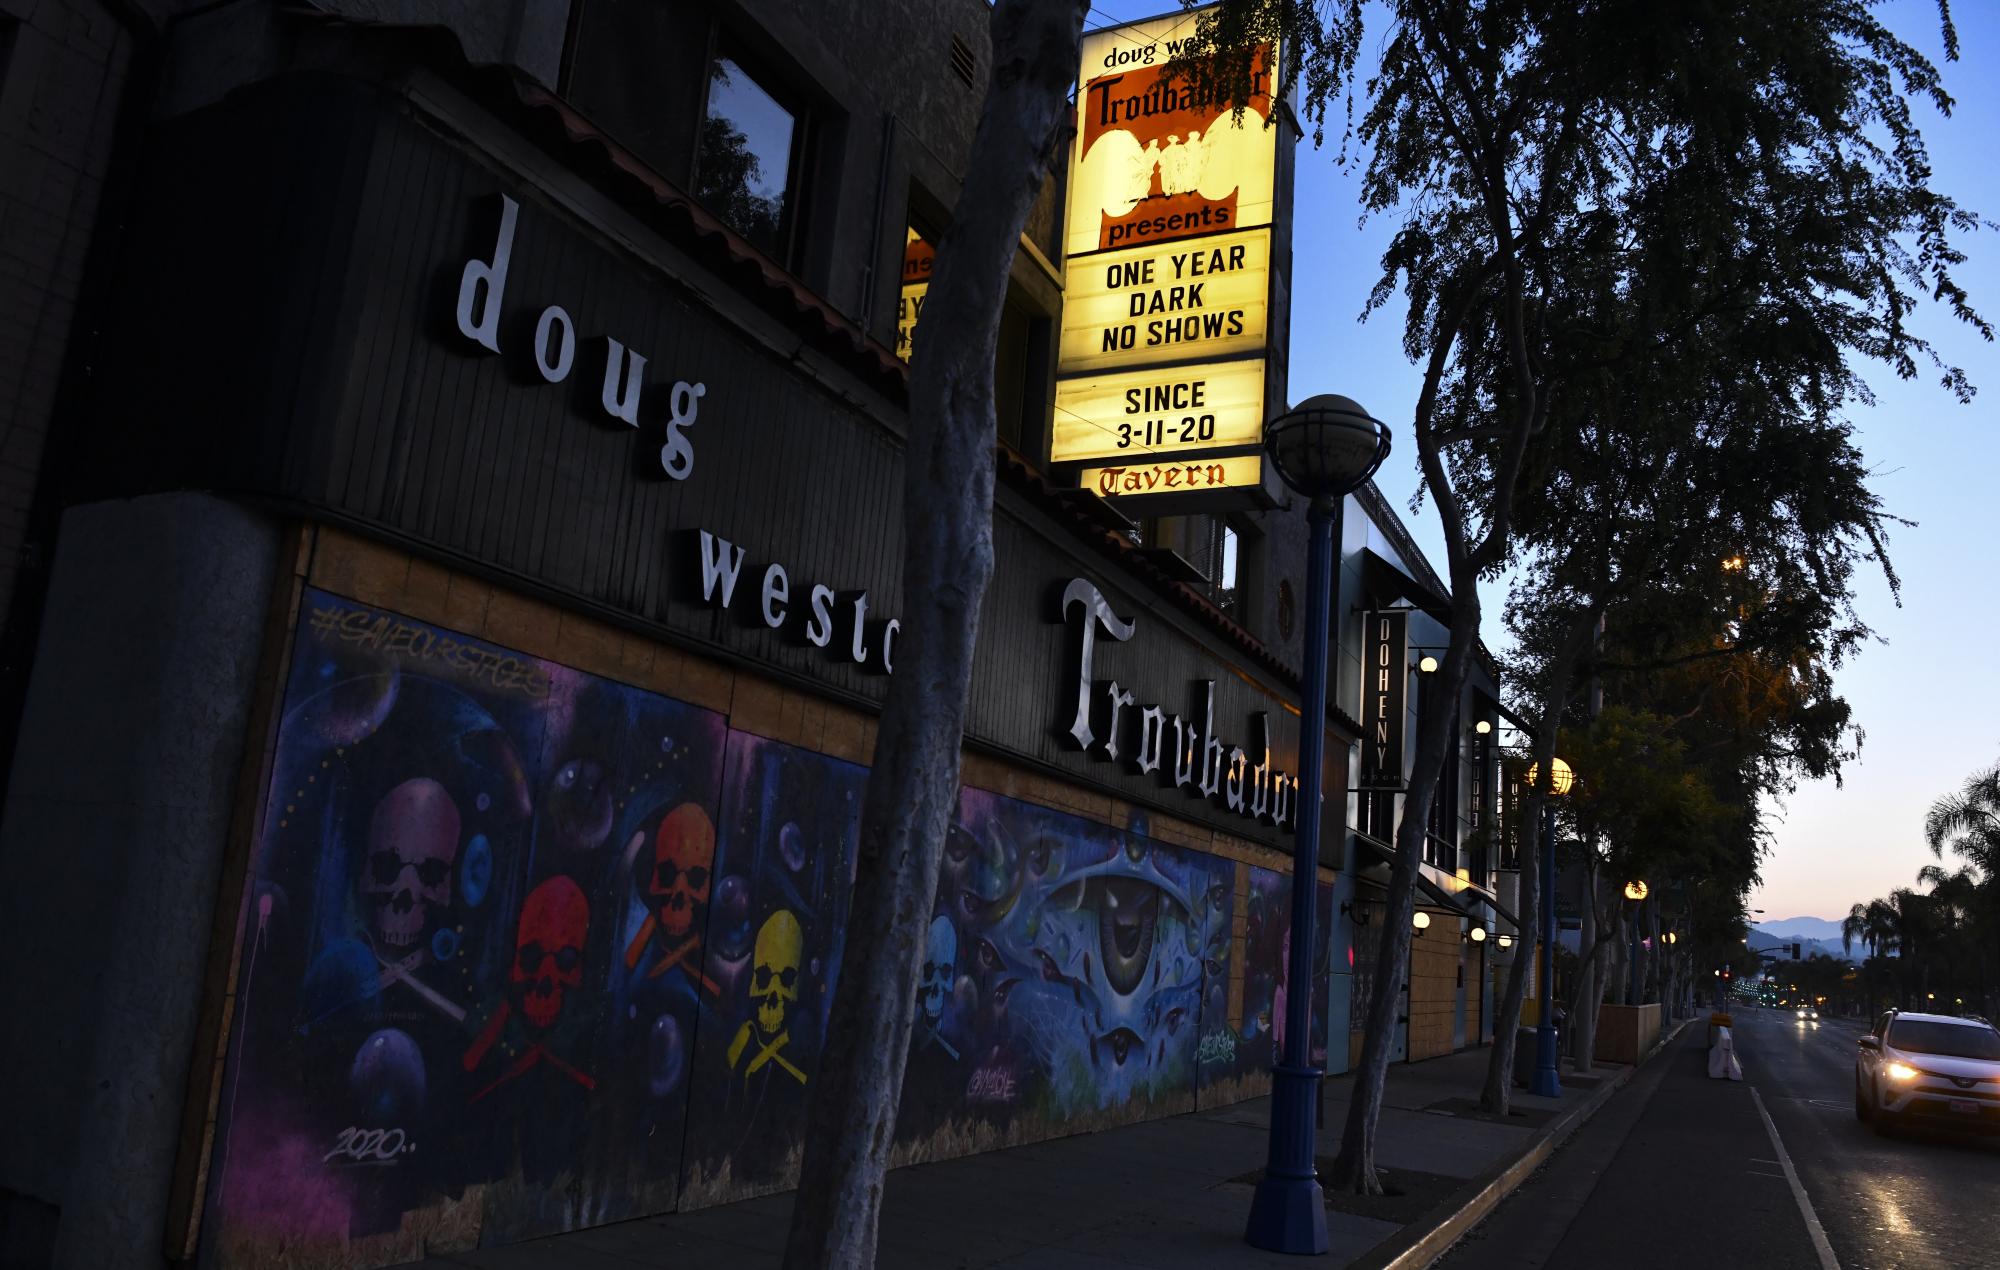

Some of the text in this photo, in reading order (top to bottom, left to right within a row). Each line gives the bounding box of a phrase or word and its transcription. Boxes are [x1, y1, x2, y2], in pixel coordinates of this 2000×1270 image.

[1103, 43, 1157, 68] doug
[1089, 70, 1267, 126] Troubadr
[1108, 205, 1229, 245] presents
[1106, 245, 1246, 289] ONE YEAR
[1129, 283, 1204, 318] DARK
[456, 192, 706, 481] doug
[1102, 310, 1244, 352] NO SHOWS
[1125, 381, 1206, 414] SINCE
[1117, 414, 1216, 449] 3-11-20
[1099, 463, 1226, 497] Tavern
[1062, 577, 1324, 831] Troubado
[1377, 618, 1390, 770] DOHENY
